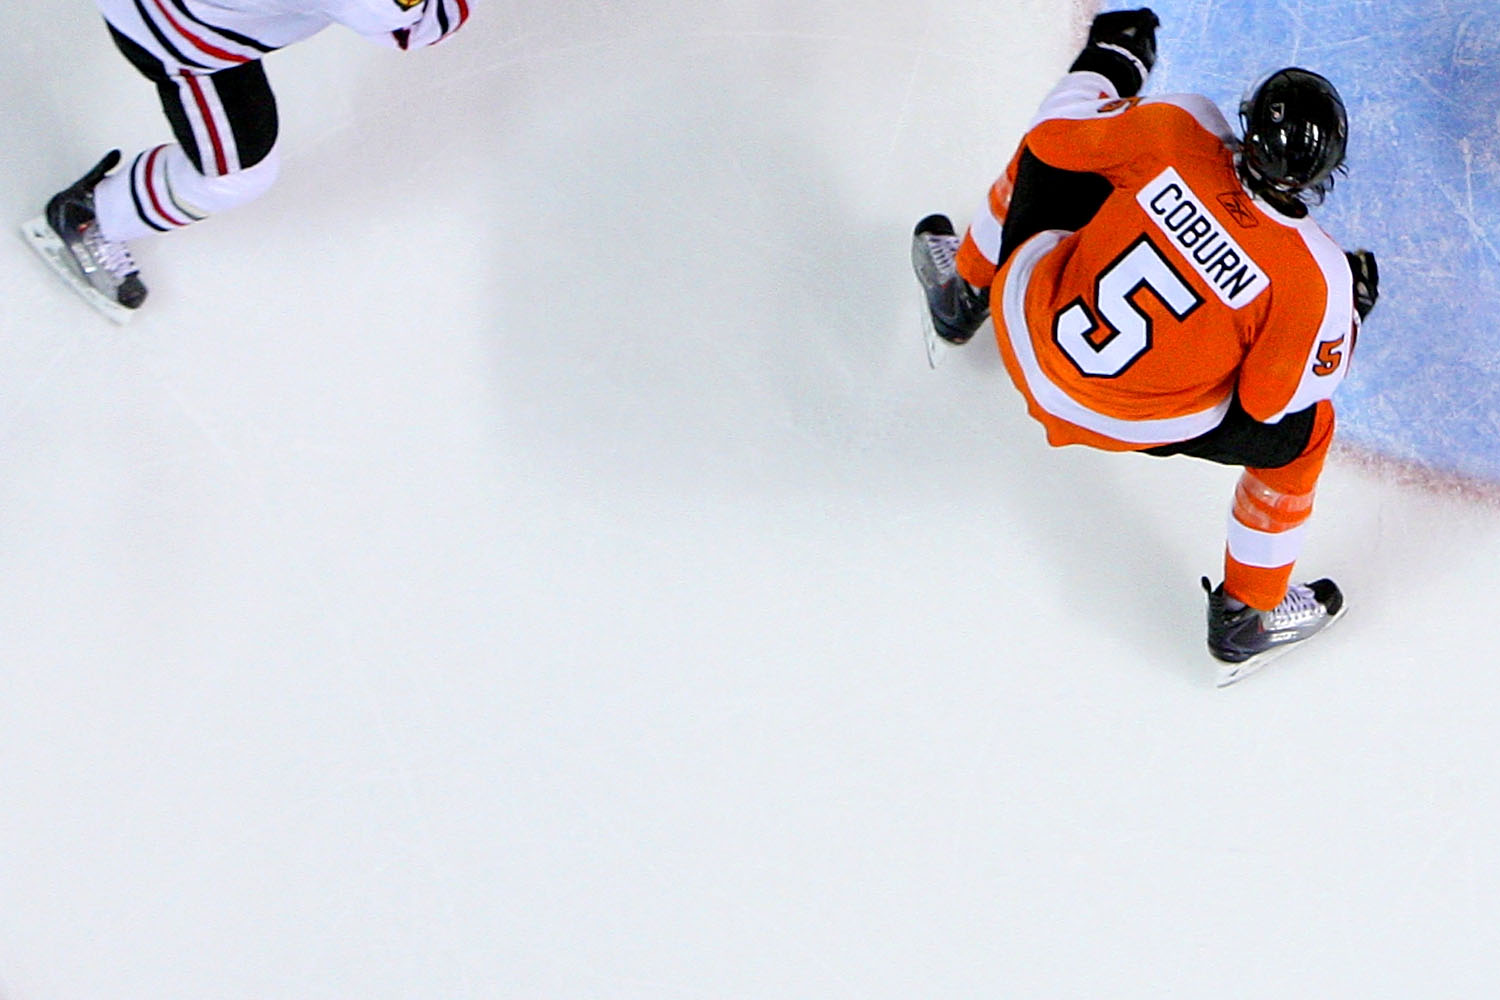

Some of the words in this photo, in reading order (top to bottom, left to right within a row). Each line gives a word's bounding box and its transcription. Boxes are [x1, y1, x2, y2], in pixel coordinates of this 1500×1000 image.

[1149, 182, 1257, 301] COBURN
[1051, 231, 1208, 379] 5
[1311, 333, 1346, 377] 5
